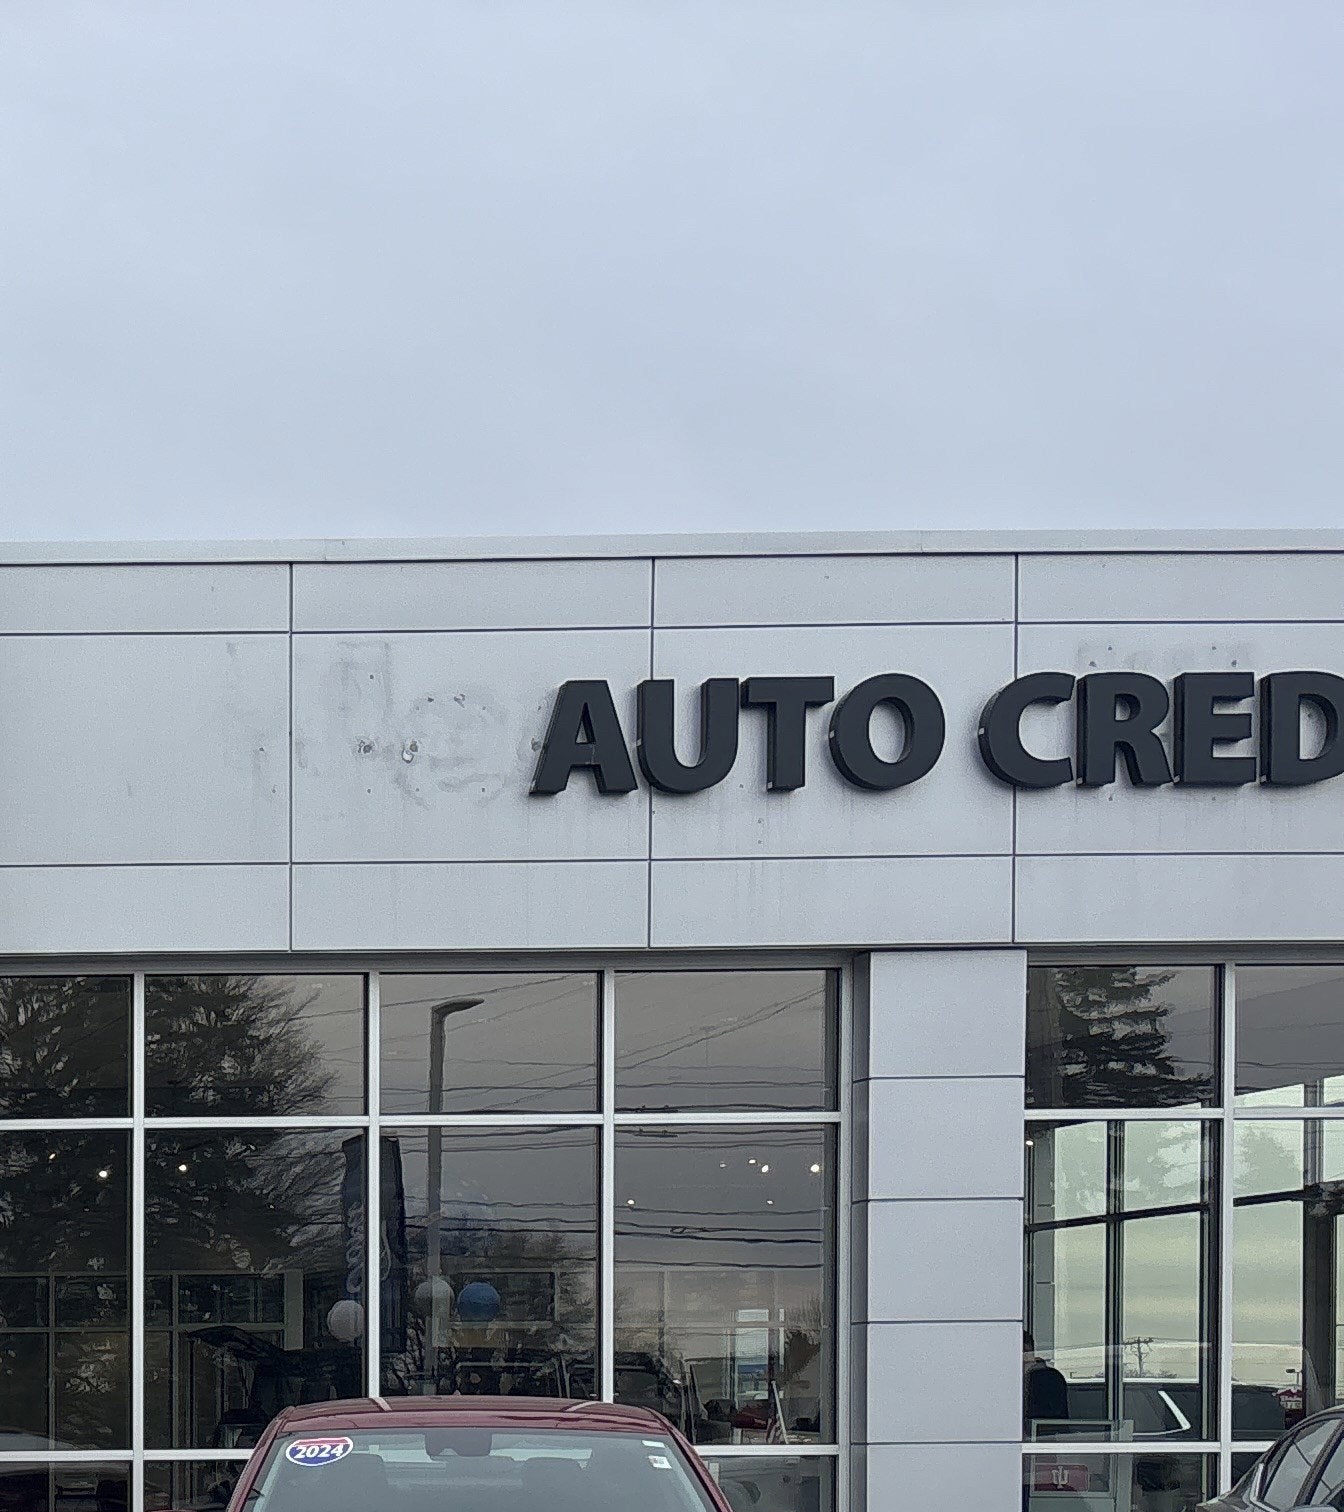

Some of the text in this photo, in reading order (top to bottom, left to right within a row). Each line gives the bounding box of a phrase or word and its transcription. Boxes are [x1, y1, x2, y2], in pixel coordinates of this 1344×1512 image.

[528, 670, 1344, 796] AUTO CRED
[293, 1444, 344, 1459] 2024
